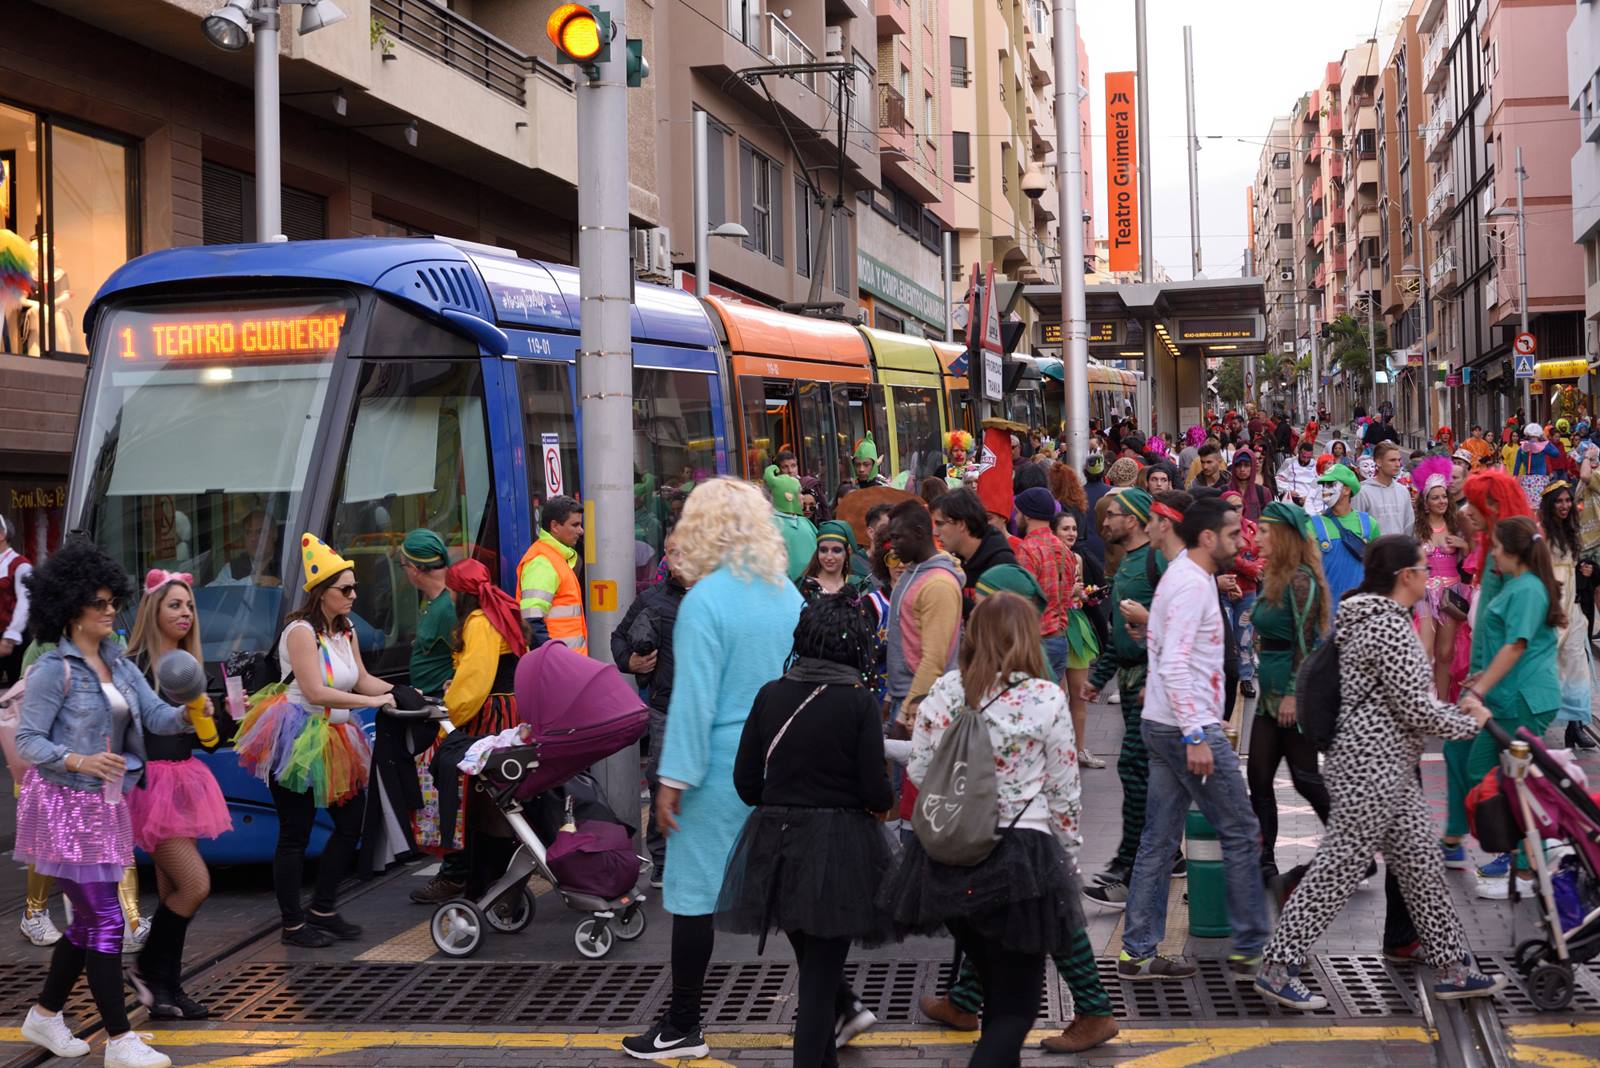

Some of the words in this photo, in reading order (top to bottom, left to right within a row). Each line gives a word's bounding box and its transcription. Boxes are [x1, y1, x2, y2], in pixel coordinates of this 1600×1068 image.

[1110, 111, 1130, 187] Guimerá
[1115, 191, 1131, 248] Teatro
[120, 327, 136, 358] 1
[152, 322, 234, 356] TEATRO
[527, 337, 551, 355] 119-01
[594, 584, 608, 606] T
